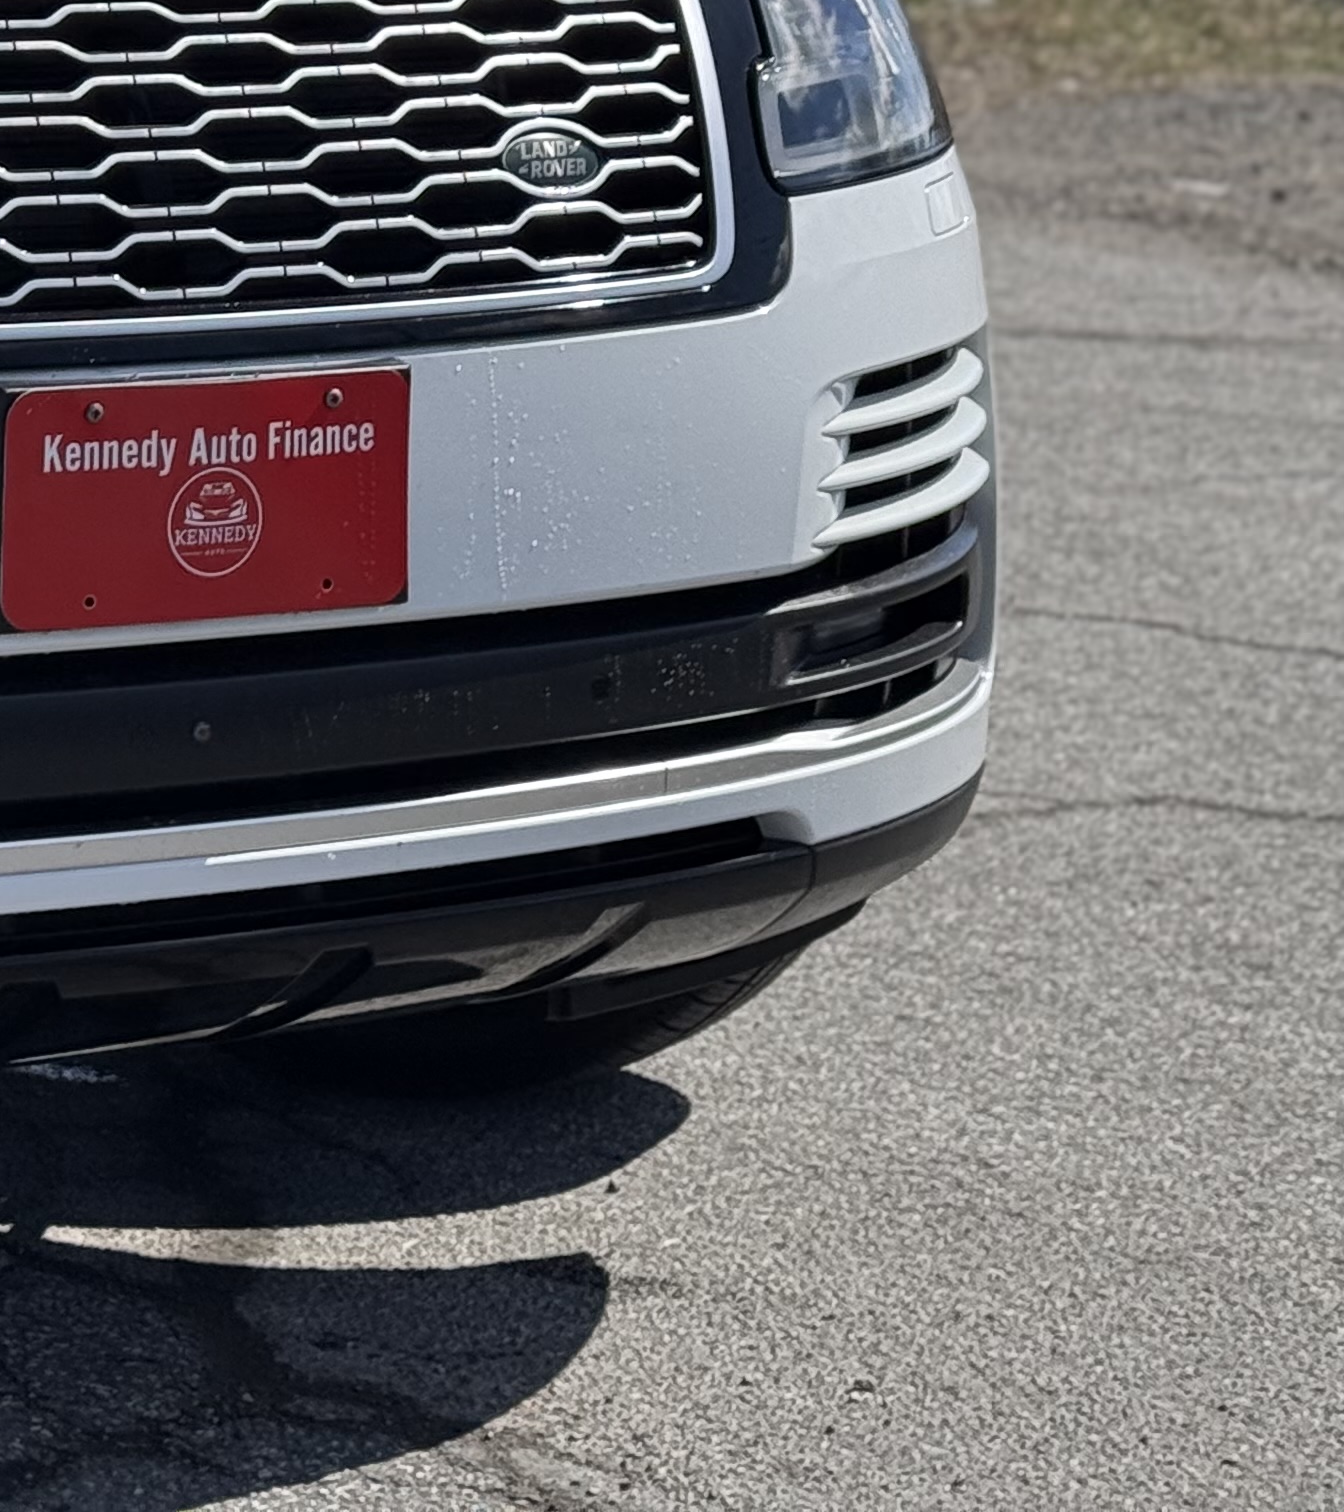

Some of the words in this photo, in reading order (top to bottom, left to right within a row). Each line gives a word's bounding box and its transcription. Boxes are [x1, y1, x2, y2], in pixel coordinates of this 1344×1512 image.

[520, 140, 568, 160] LAND
[531, 157, 587, 179] ROVER
[42, 430, 177, 477] Kennedy
[188, 427, 257, 467] Auto
[267, 420, 376, 460] Finance
[174, 523, 257, 547] KENNEDY
